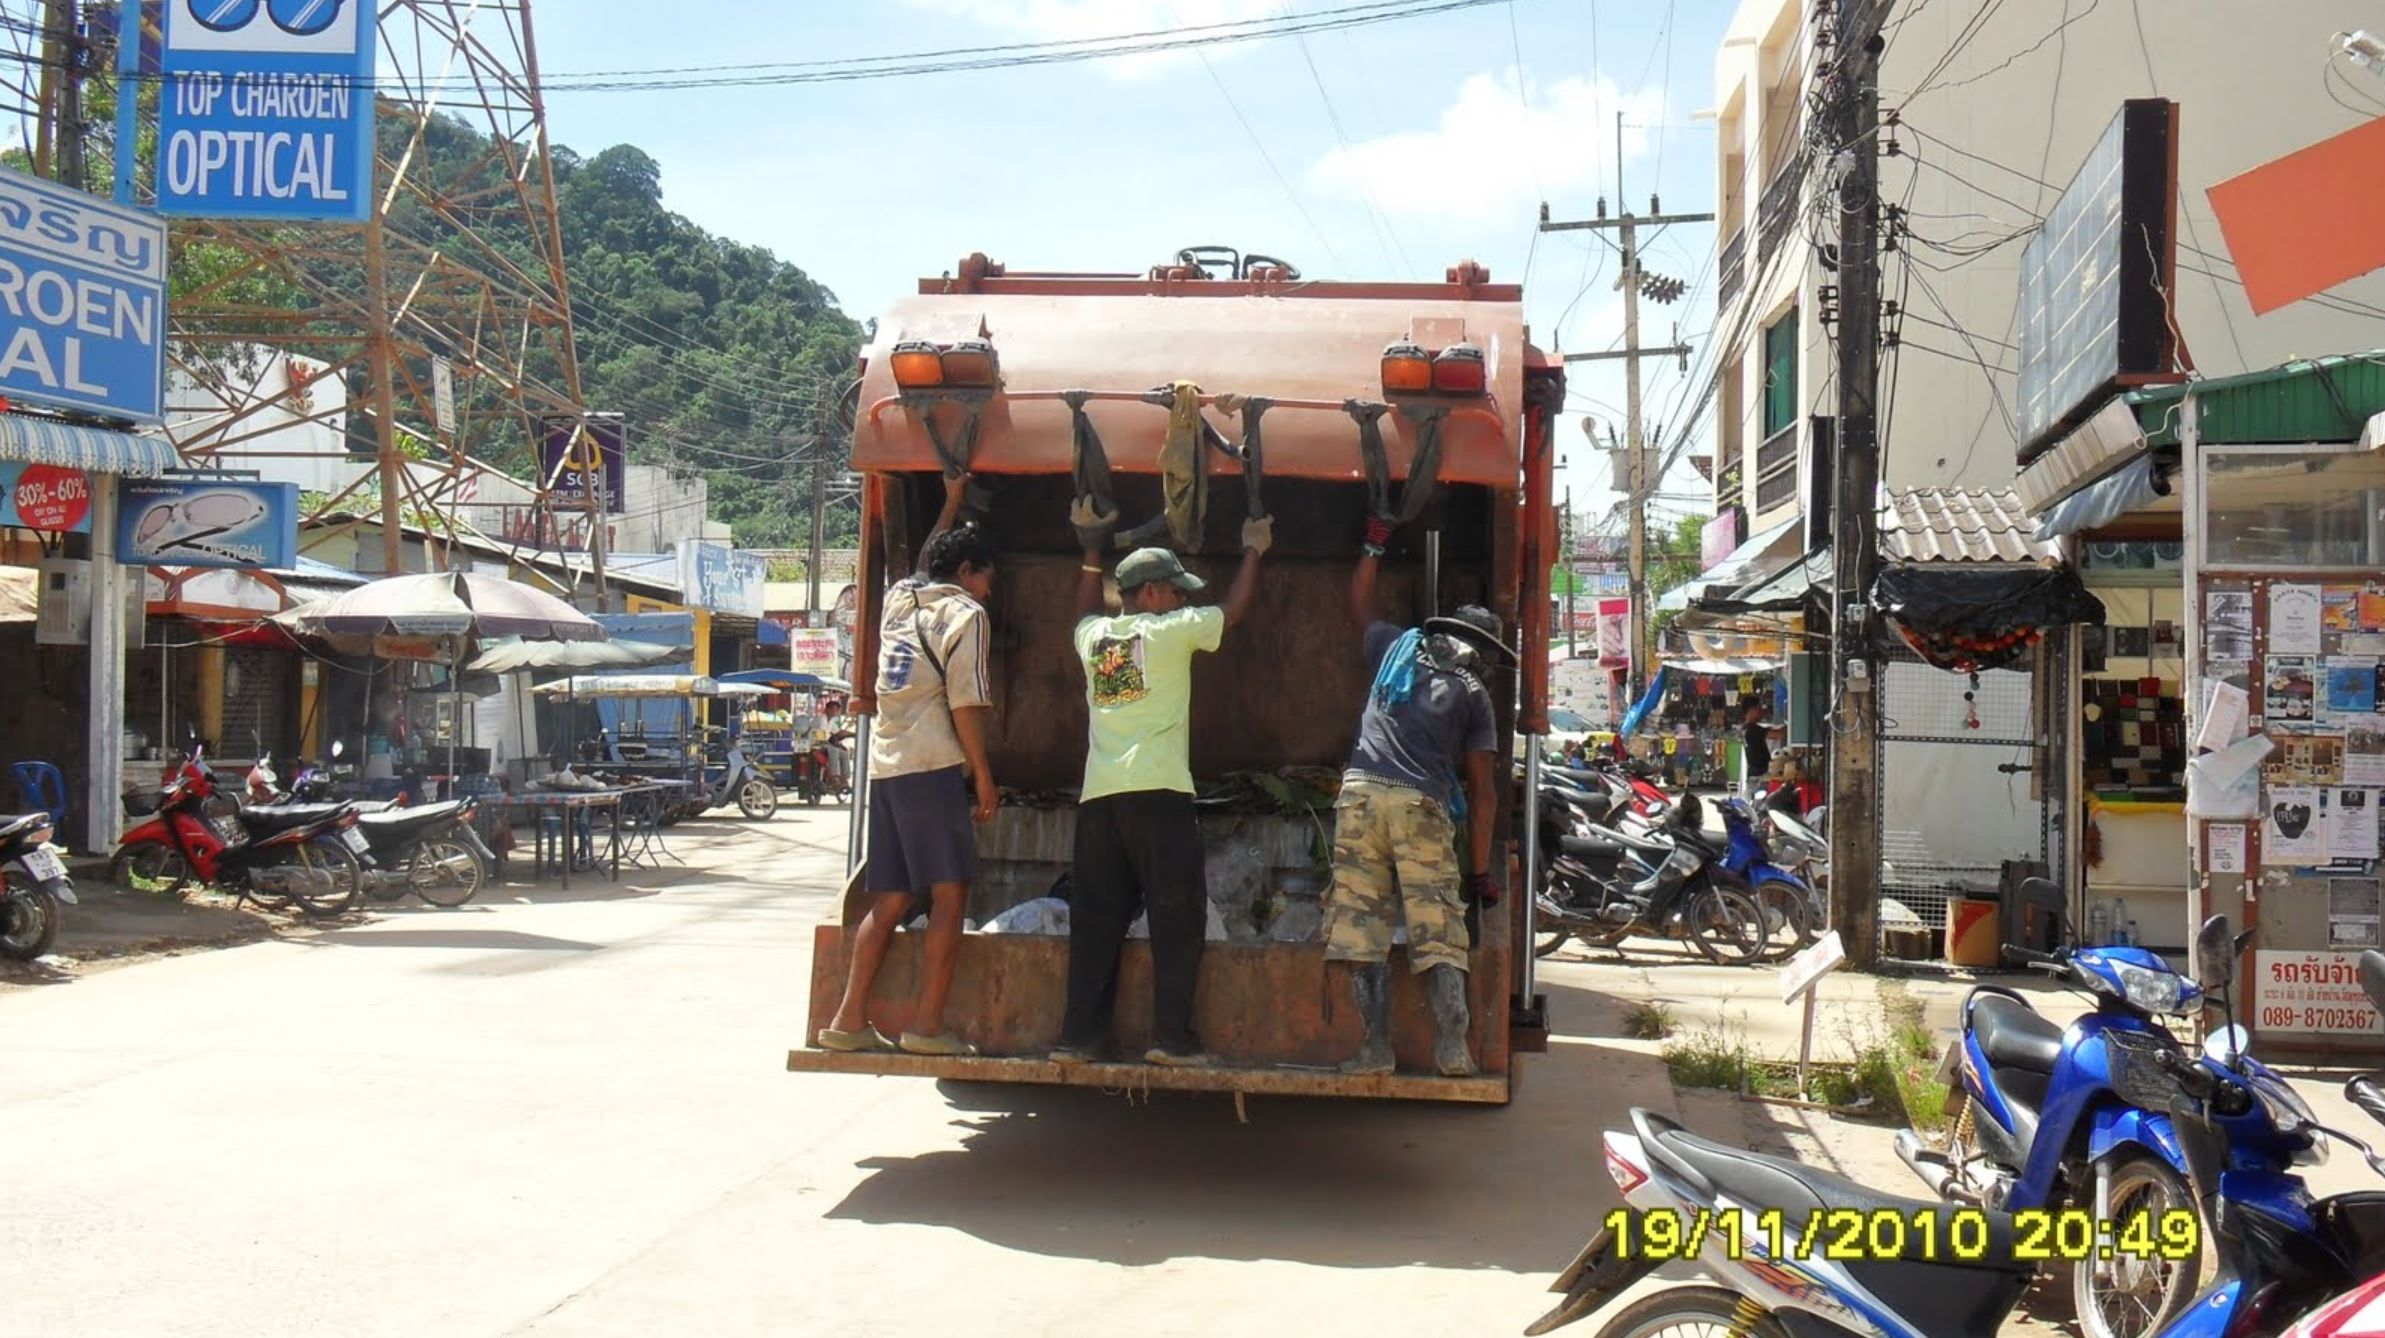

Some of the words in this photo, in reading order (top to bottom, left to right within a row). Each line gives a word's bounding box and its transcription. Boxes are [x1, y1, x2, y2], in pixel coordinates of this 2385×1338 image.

[172, 70, 223, 116] TOP
[230, 70, 350, 119] CHAROEN
[167, 129, 348, 200] OPTICAL
